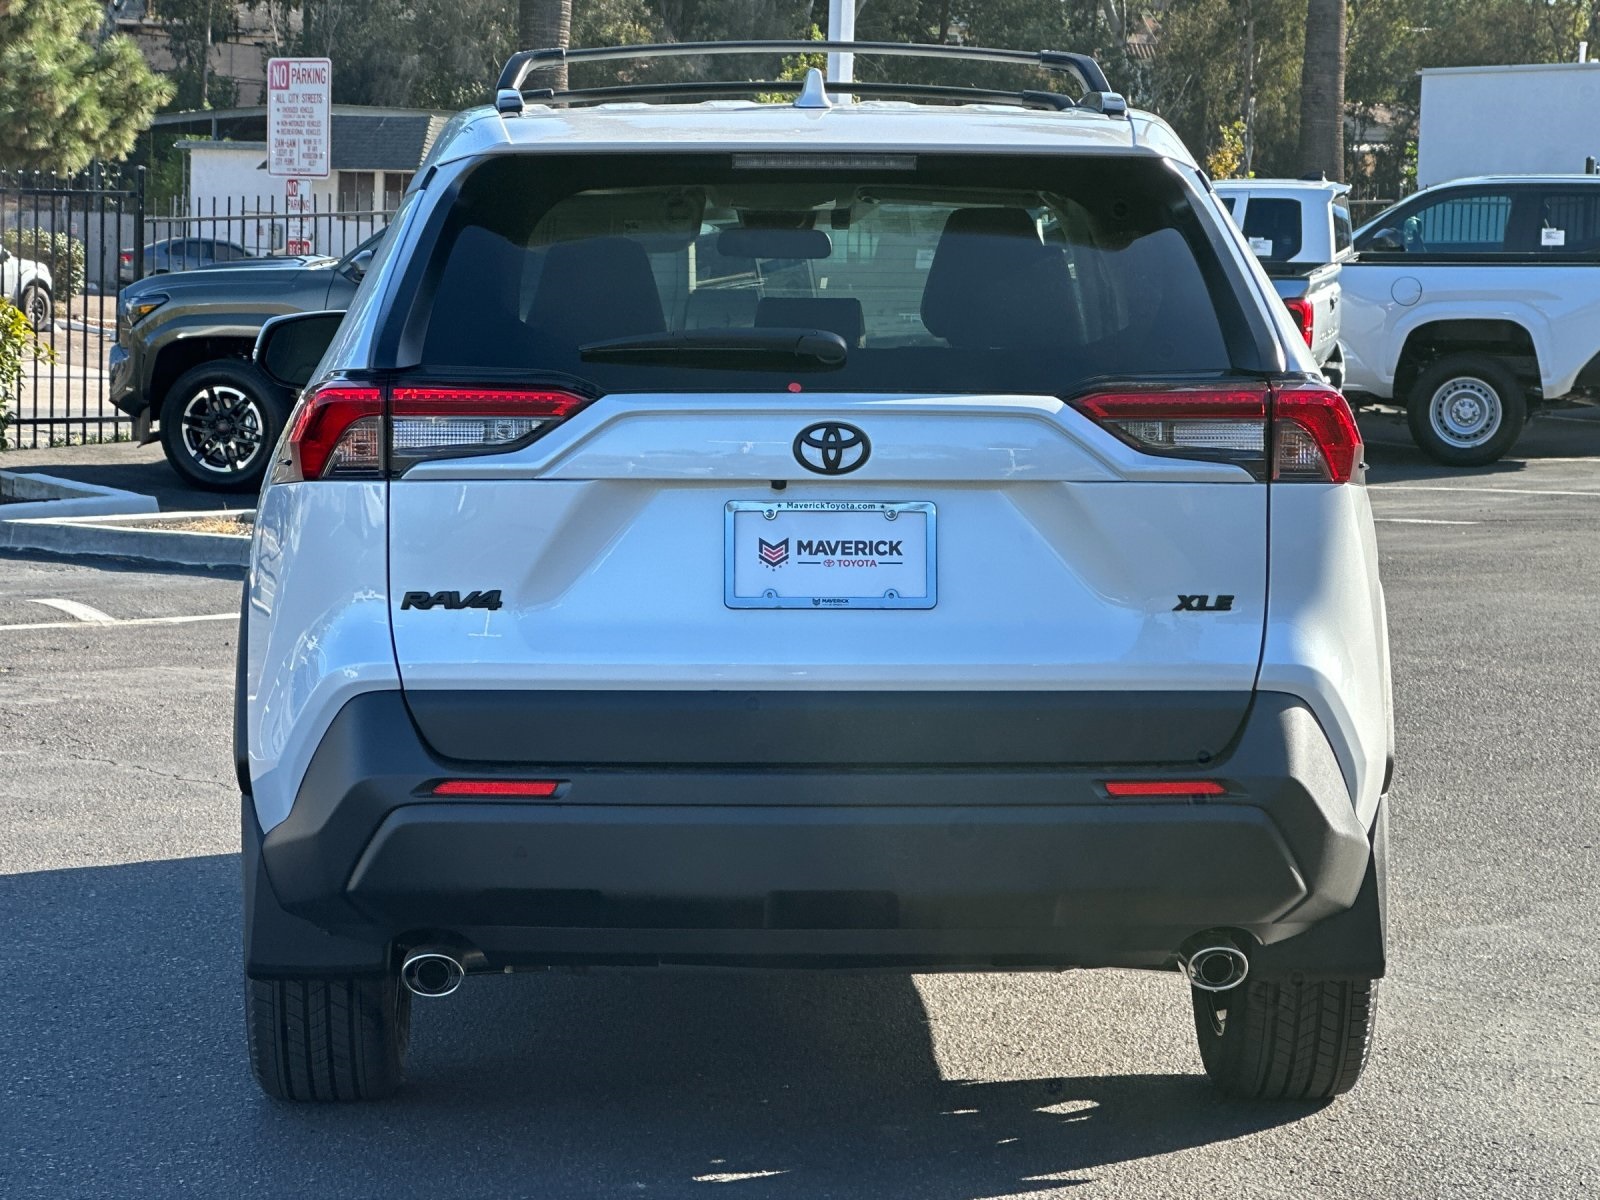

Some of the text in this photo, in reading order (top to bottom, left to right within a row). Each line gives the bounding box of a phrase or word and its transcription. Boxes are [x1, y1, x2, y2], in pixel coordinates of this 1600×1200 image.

[272, 64, 326, 87] NO PARKING
[276, 93, 322, 104] ALL CITY STREETS
[287, 181, 297, 196] NO
[288, 200, 310, 211] PARKNG
[289, 244, 309, 255] BEGN
[786, 502, 876, 510] MaverickToyota.com
[797, 540, 903, 556] MAVERICK
[400, 590, 503, 610] RAV4
[1172, 595, 1235, 611] XLE
